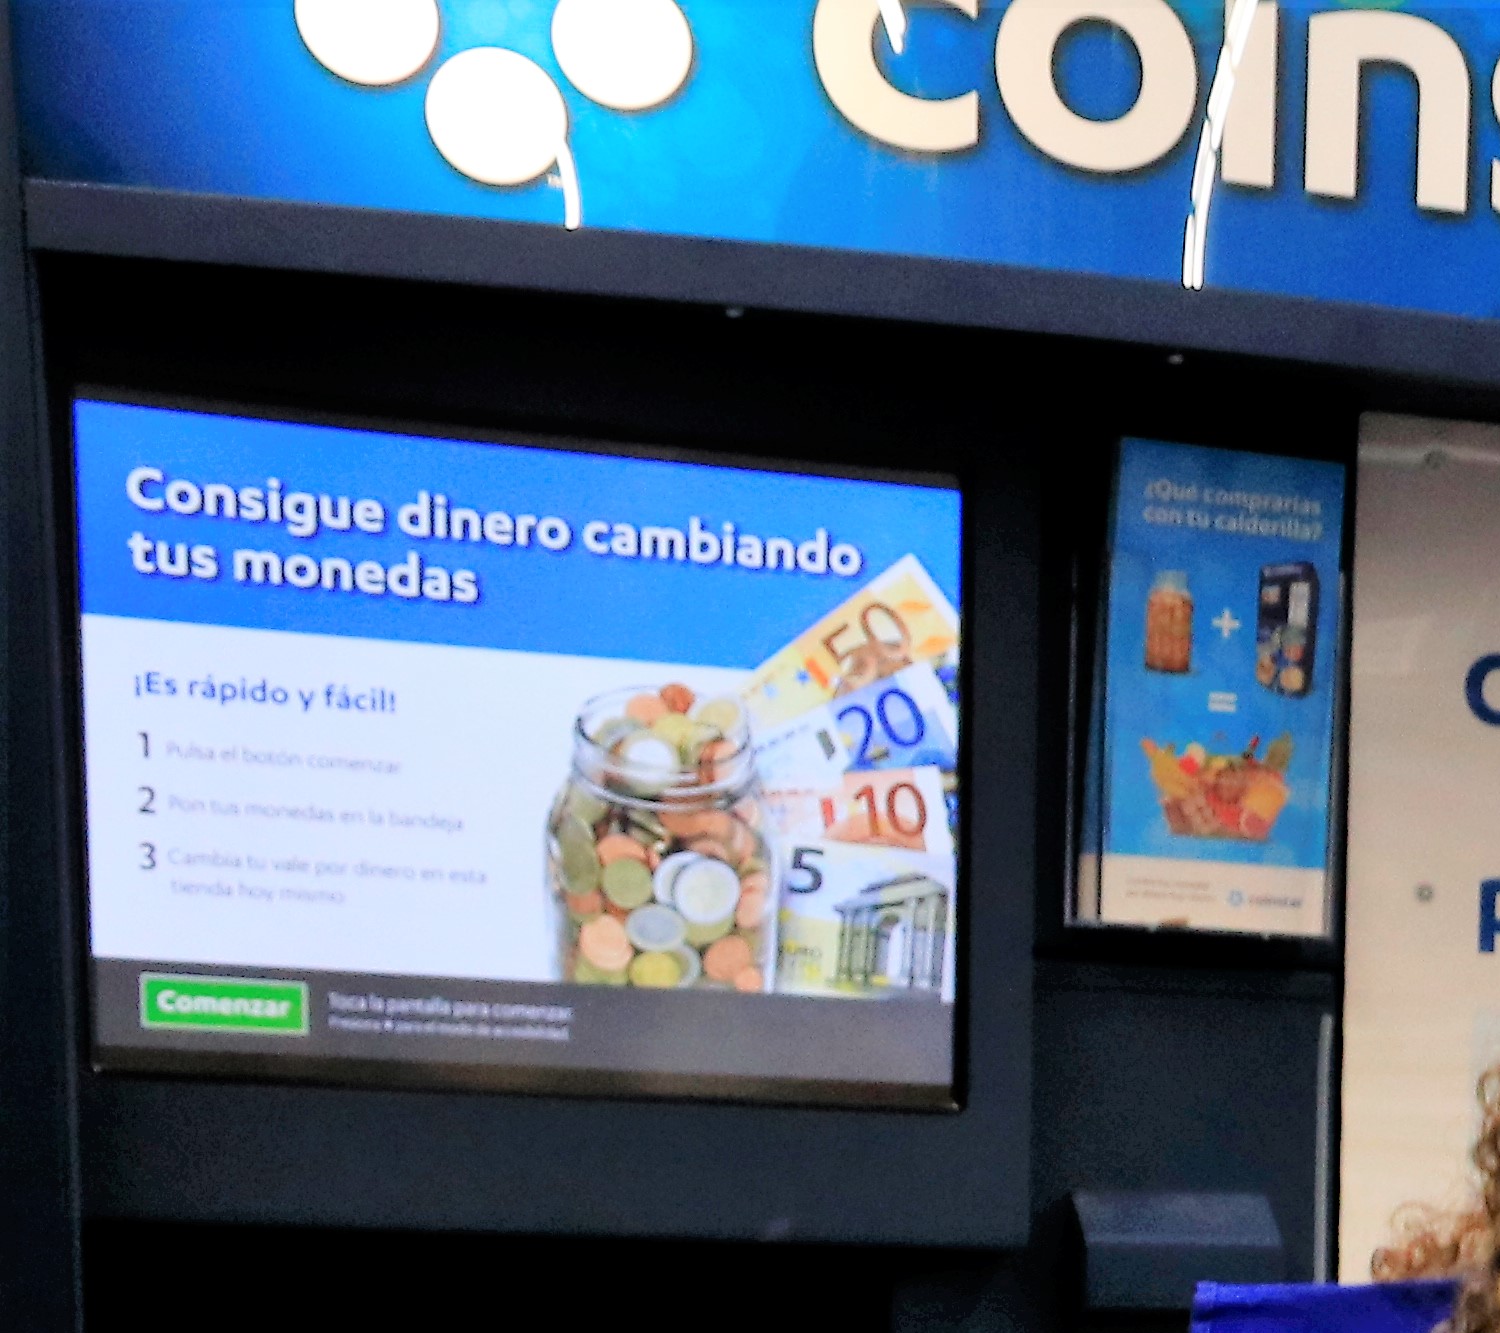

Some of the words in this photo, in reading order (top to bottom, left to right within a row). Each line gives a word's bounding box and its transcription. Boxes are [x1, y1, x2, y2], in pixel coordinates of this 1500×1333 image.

[127, 467, 388, 537] Consigue
[399, 492, 573, 551] dinero
[583, 516, 864, 579] cambiando
[129, 531, 219, 578] tus
[234, 545, 479, 604] monedas
[188, 674, 290, 706] rápido
[299, 687, 316, 713] y
[324, 682, 397, 714] fácil!
[138, 731, 151, 759] 1
[837, 687, 926, 768] 20
[138, 785, 157, 815] 2
[854, 782, 928, 838] 10
[138, 842, 157, 870] 3
[789, 847, 825, 895] 5
[156, 988, 293, 1018] Comenzar
